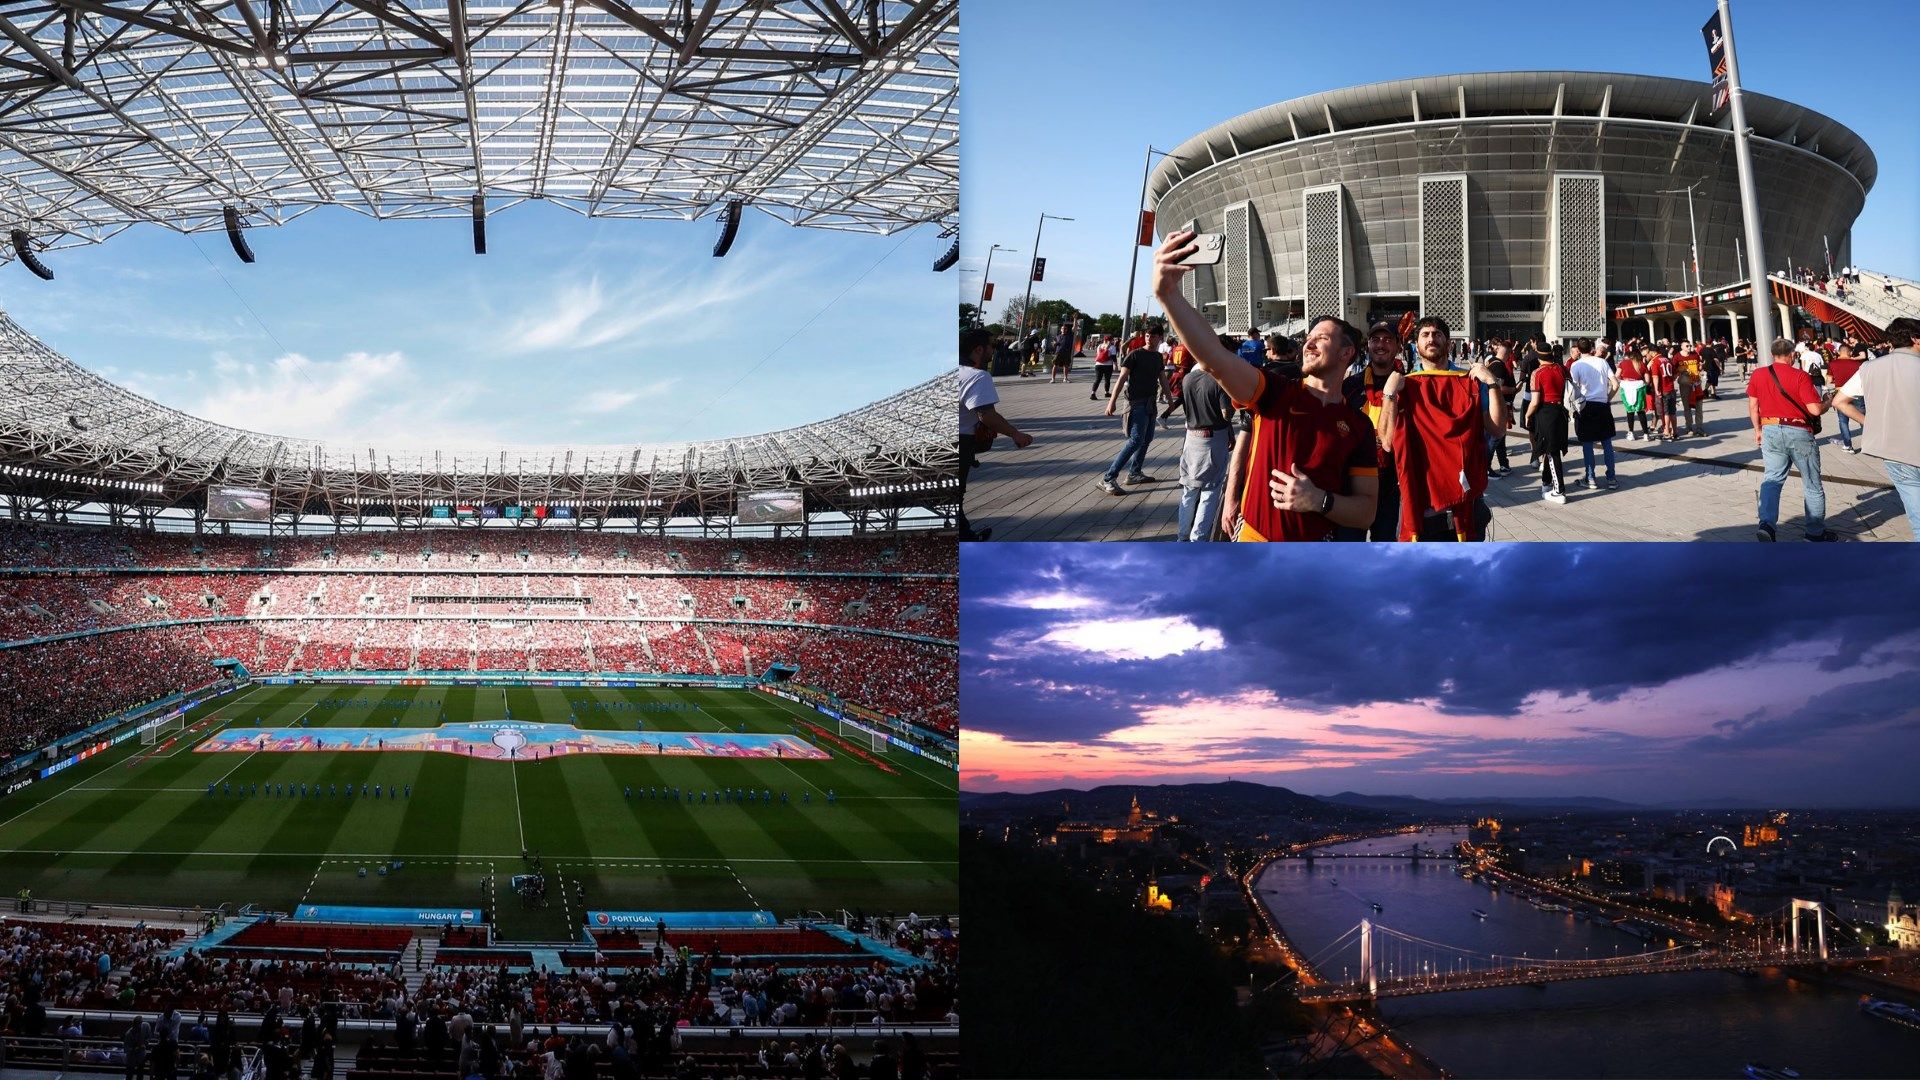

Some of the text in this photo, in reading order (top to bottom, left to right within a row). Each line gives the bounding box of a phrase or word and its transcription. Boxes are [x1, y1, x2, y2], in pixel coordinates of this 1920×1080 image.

[1257, 301, 1262, 309] D
[1660, 362, 1673, 377] 10
[920, 749, 947, 766] Heineken
[13, 778, 33, 791] TikTok
[418, 912, 458, 920] HUNGARY
[611, 915, 655, 923] PORTUGAL
